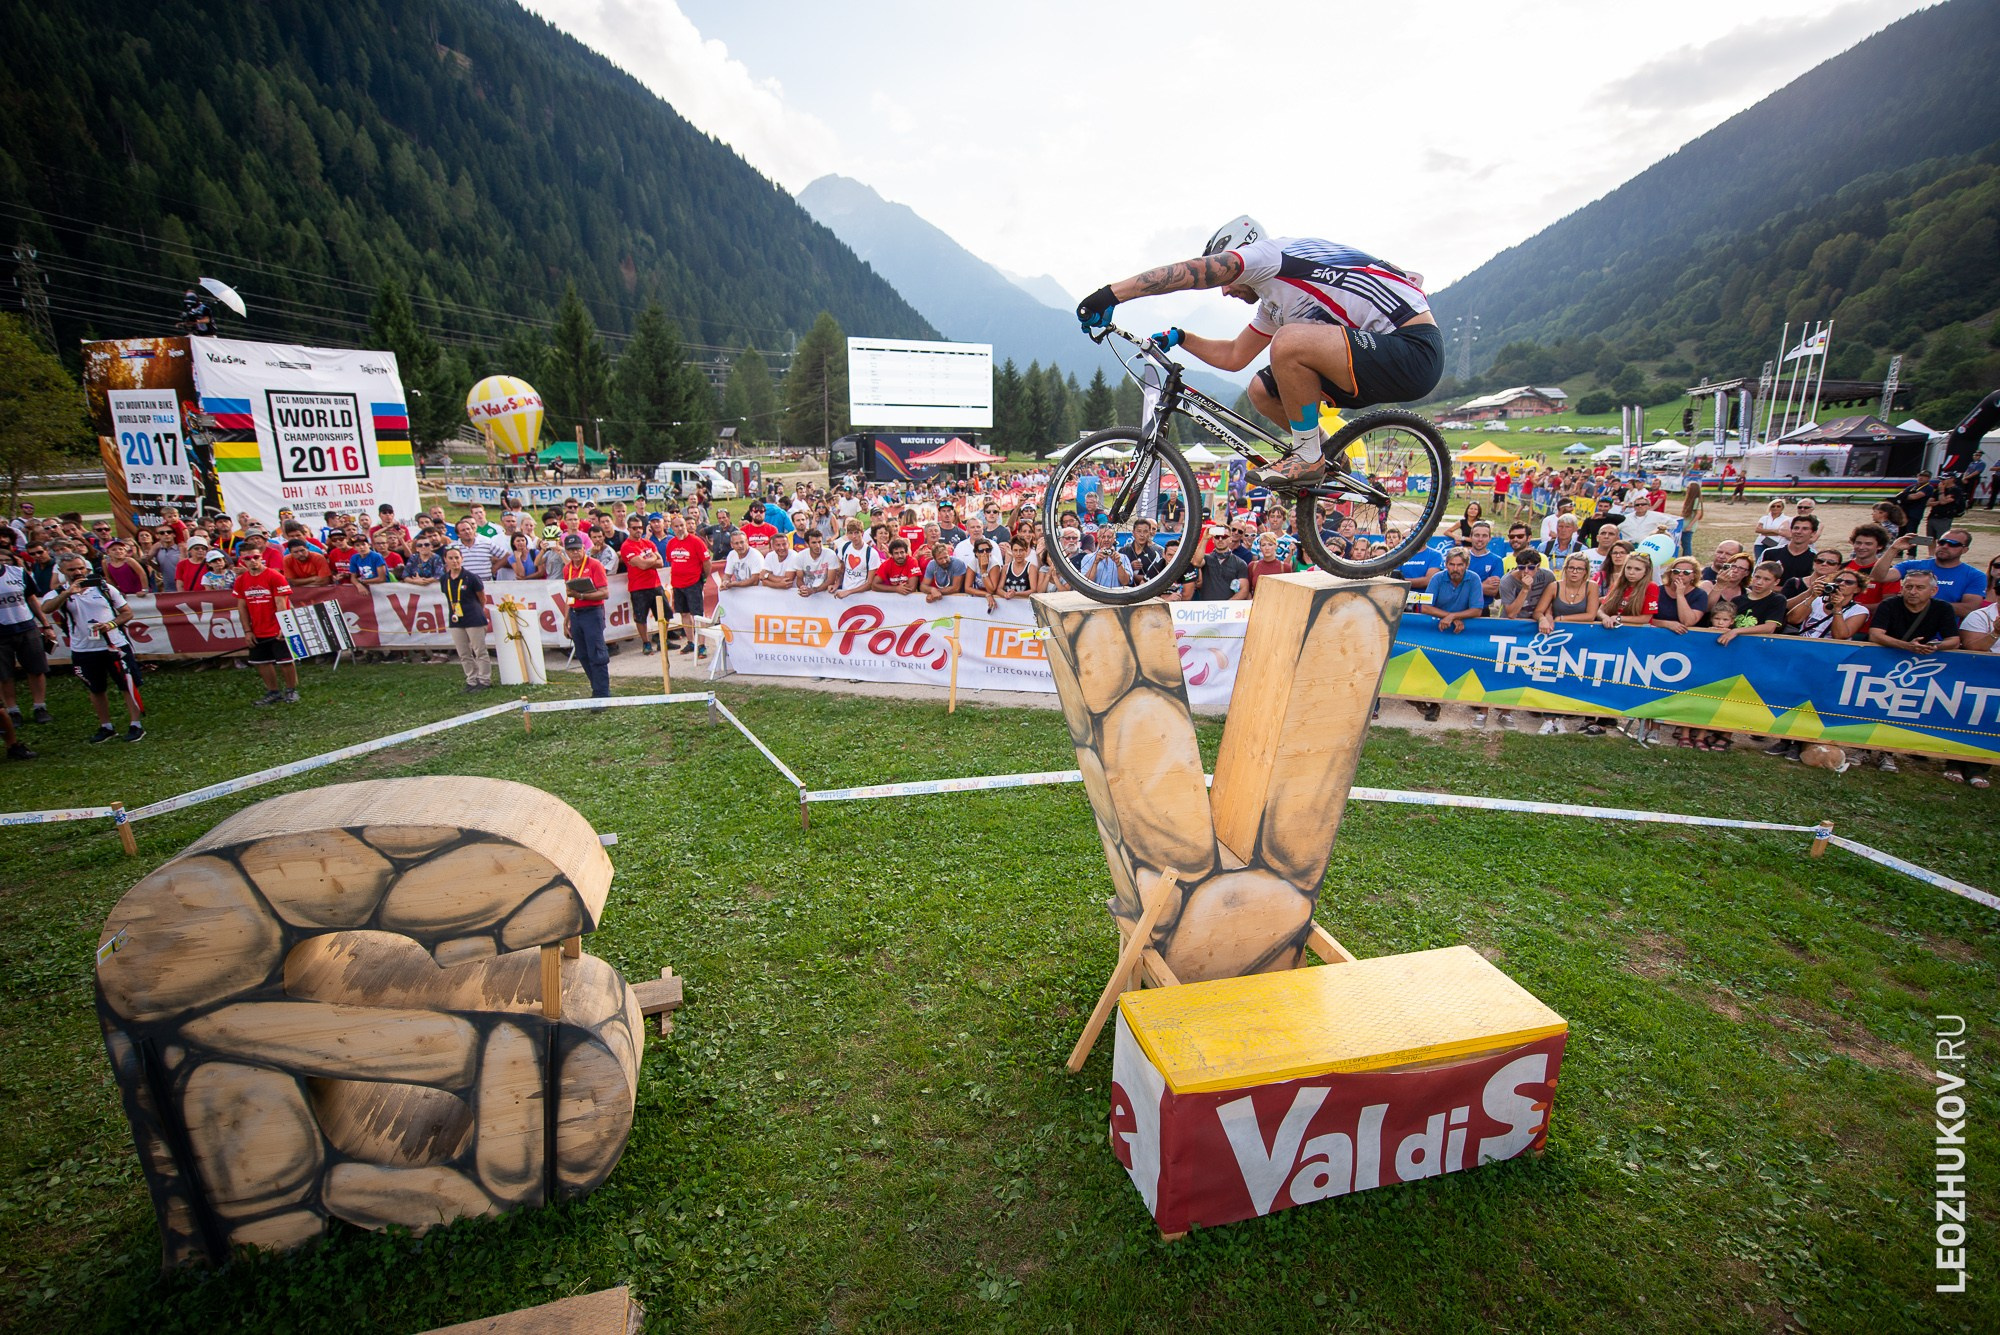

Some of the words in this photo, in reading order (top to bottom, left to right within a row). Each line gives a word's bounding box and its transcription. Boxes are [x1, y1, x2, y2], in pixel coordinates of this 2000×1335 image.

[1311, 268, 1344, 285] sky
[115, 401, 125, 410] UCI
[126, 401, 157, 410] MOUNTAIN
[158, 401, 174, 410] BIKE
[276, 396, 290, 404] UCI
[292, 397, 331, 405] MOUNTAIN
[278, 408, 353, 428] WORLD
[482, 402, 502, 418] Val
[118, 415, 138, 424] WORLD
[139, 415, 151, 424] CUP
[153, 415, 175, 424] FINALS
[284, 433, 354, 442] CHAMPIONSHIPS
[900, 437, 924, 445] WATCH
[926, 437, 935, 445] IT
[935, 437, 946, 445] ON
[121, 432, 178, 466] 2017
[290, 446, 359, 473] 2016
[131, 472, 147, 484] 25TH
[153, 472, 169, 485] 27TH
[170, 475, 188, 485] AUG.
[283, 487, 303, 499] DHI
[314, 485, 328, 497] 4X
[338, 483, 373, 495] TRIALS
[456, 487, 474, 500] PEJO
[478, 487, 498, 500] PEJO
[531, 488, 562, 500] PEJO
[571, 487, 600, 500] PEJO
[607, 485, 635, 498] PEJO
[293, 502, 326, 511] MASTERS
[329, 501, 342, 509] DHI
[344, 500, 358, 508] AND
[176, 602, 246, 642] Val
[387, 593, 447, 636] Val
[609, 602, 630, 627] di
[759, 617, 823, 642] IPER
[838, 604, 937, 657] Poli
[989, 630, 1049, 659] IPE
[755, 653, 844, 666] IPERCONVENIENZA
[849, 658, 876, 668] TUTTI
[890, 661, 926, 670] GIORNI
[1489, 635, 1692, 687] TRENTINO
[985, 666, 1052, 678] IPERCONVEN
[1216, 1086, 1389, 1216] Val
[1396, 1106, 1469, 1181] di
